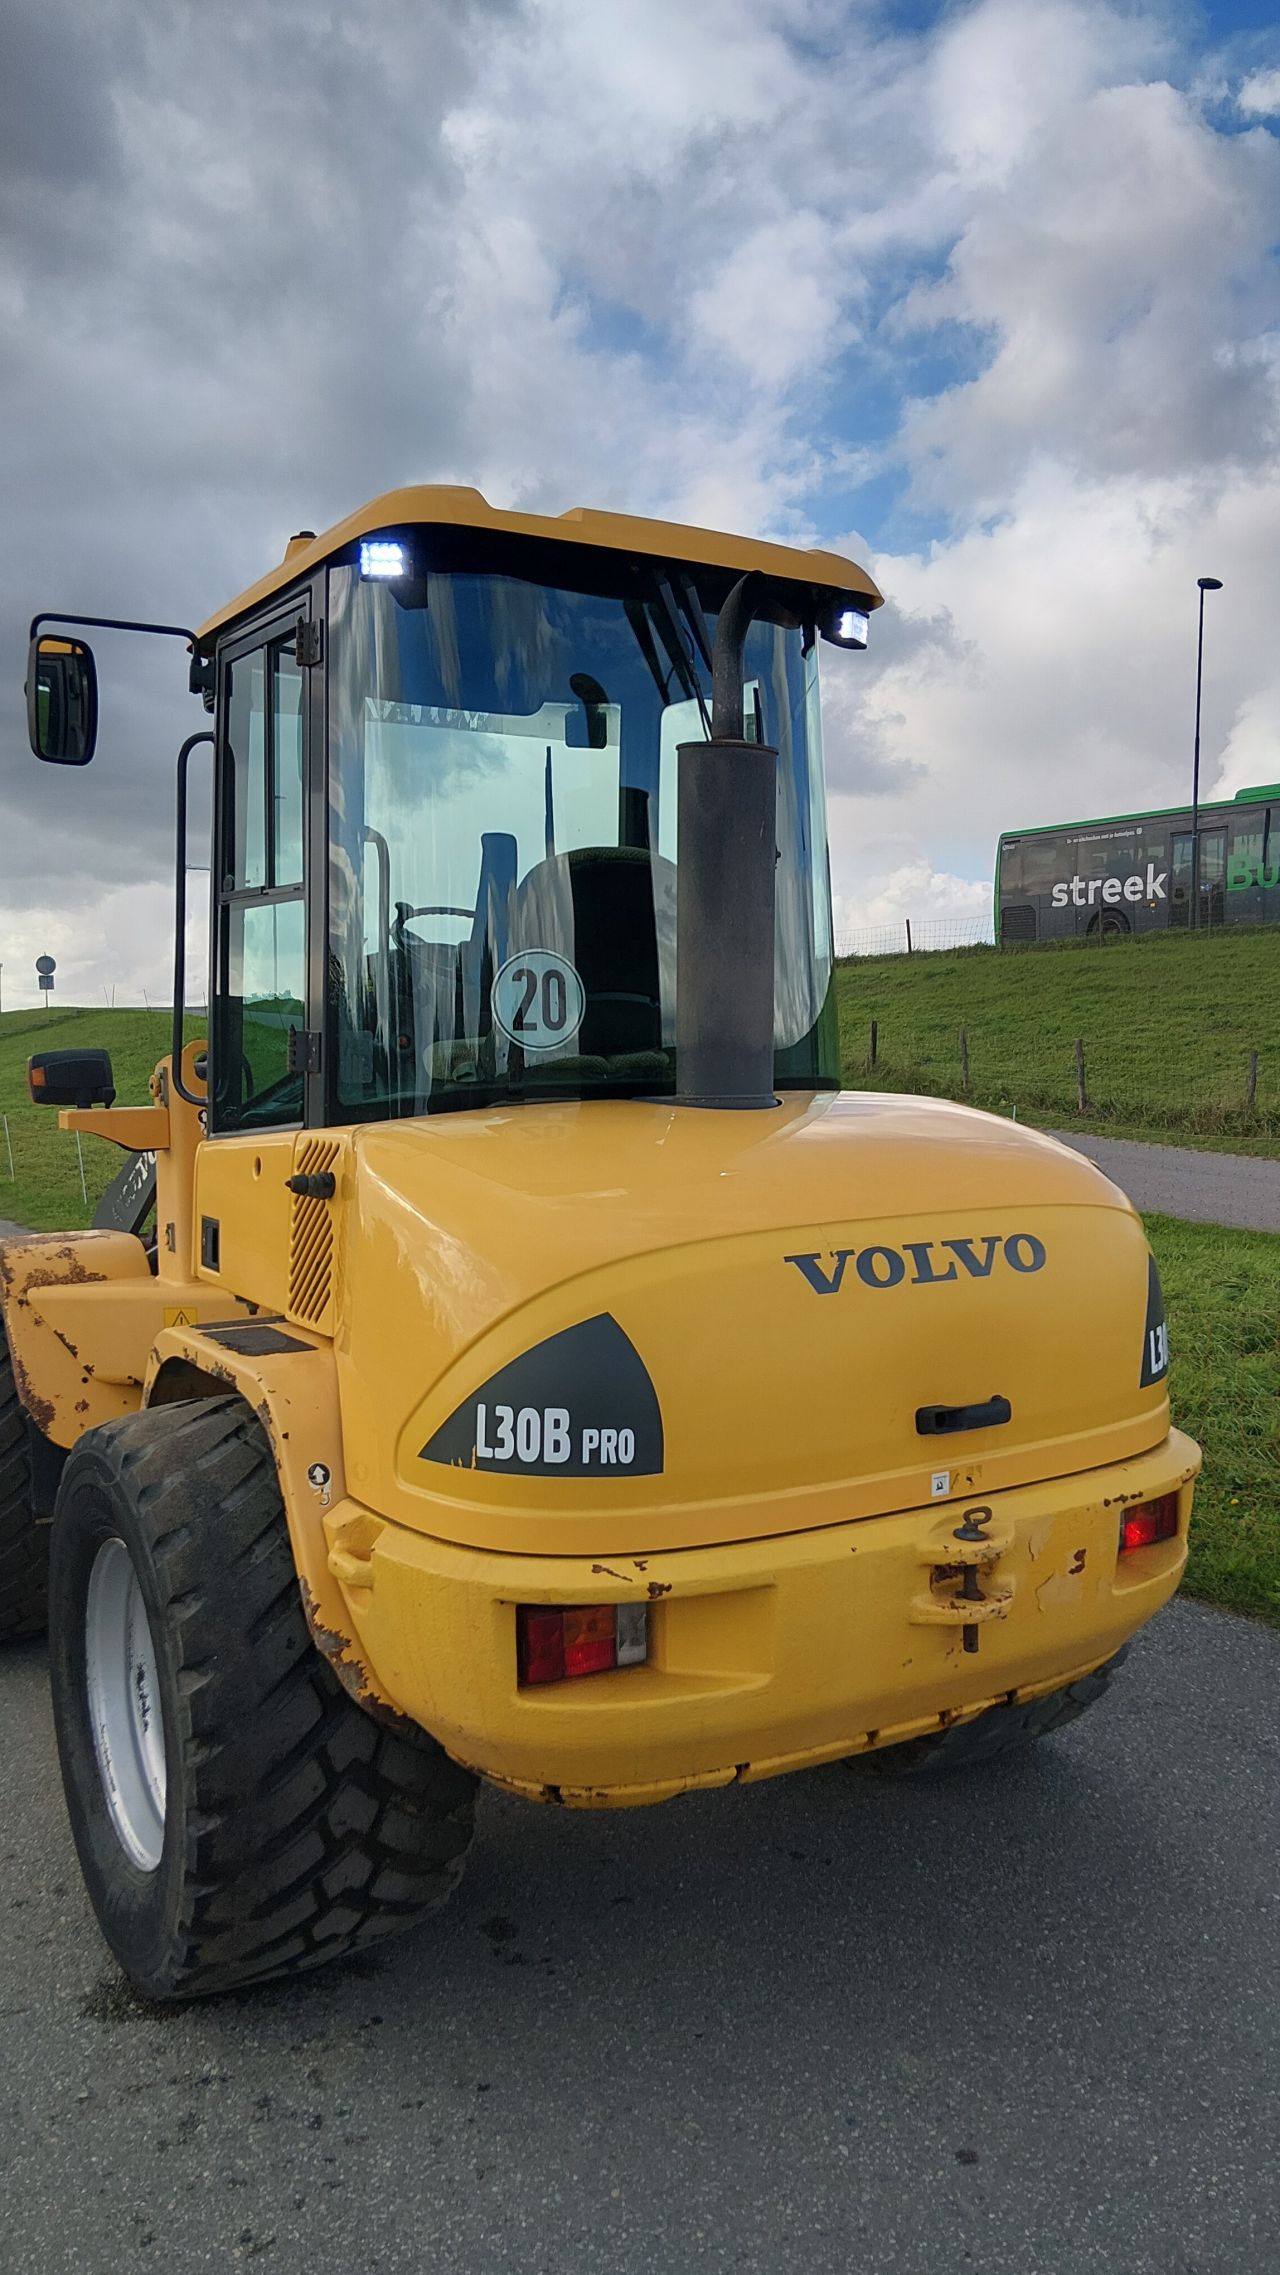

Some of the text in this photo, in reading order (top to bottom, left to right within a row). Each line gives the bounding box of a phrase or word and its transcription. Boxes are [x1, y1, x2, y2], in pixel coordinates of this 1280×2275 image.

[1051, 863, 1168, 907] streek
[511, 968, 567, 1031] 20
[784, 1233, 1046, 1295] VOLVO
[476, 1403, 635, 1465] L30B PRO
